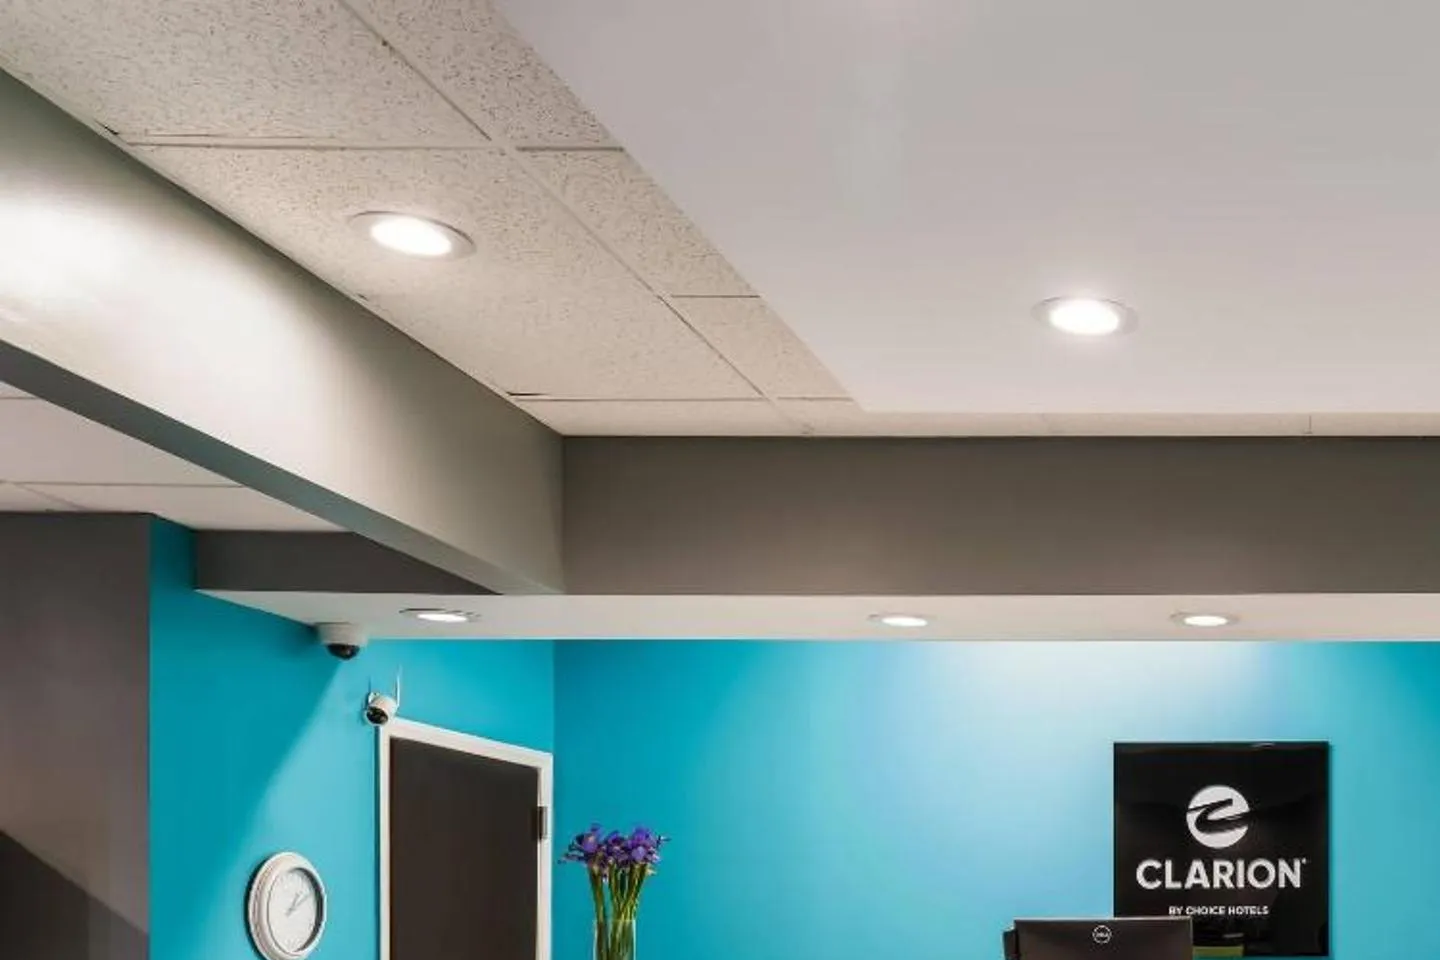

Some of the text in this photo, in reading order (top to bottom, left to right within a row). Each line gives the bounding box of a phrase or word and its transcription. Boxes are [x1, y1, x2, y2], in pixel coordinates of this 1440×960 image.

[1135, 858, 1303, 890] CLARION
[1168, 905, 1270, 916] BY CHOICE HOTELS
